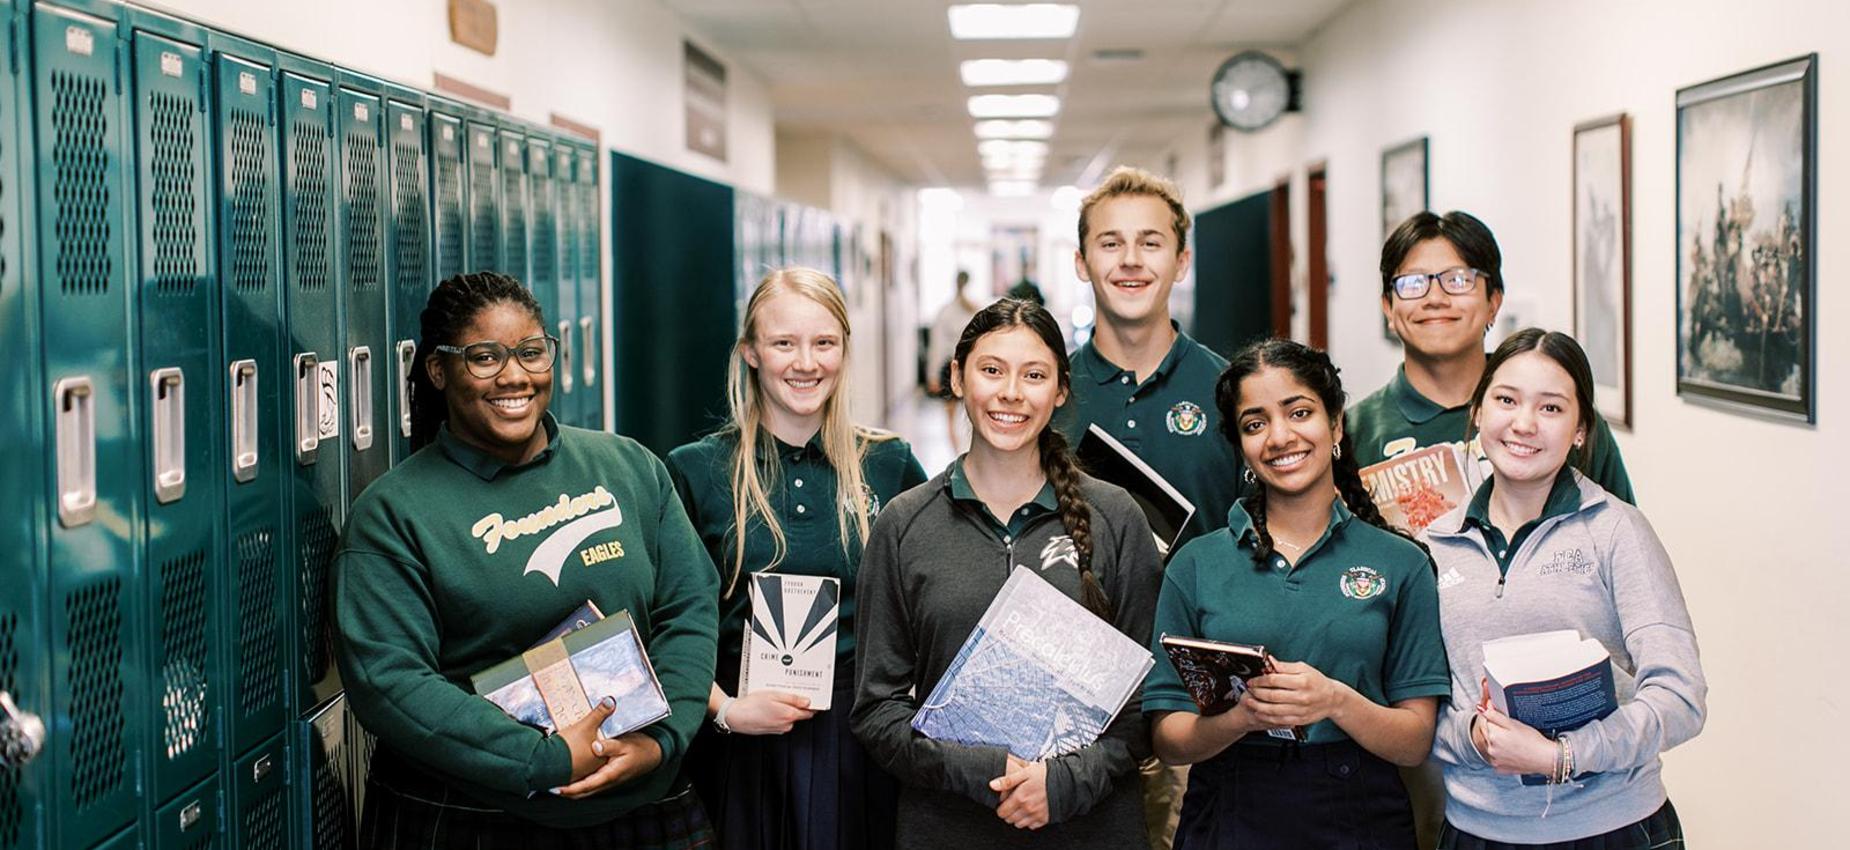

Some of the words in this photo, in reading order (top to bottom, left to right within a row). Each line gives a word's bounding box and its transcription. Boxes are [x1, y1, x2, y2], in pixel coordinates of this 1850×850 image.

[472, 485, 612, 554] Founders
[580, 541, 625, 567] EAGLES
[760, 652, 779, 661] CRIME
[1003, 610, 1104, 690] Precalculus
[784, 669, 824, 679] PUNISHMENT
